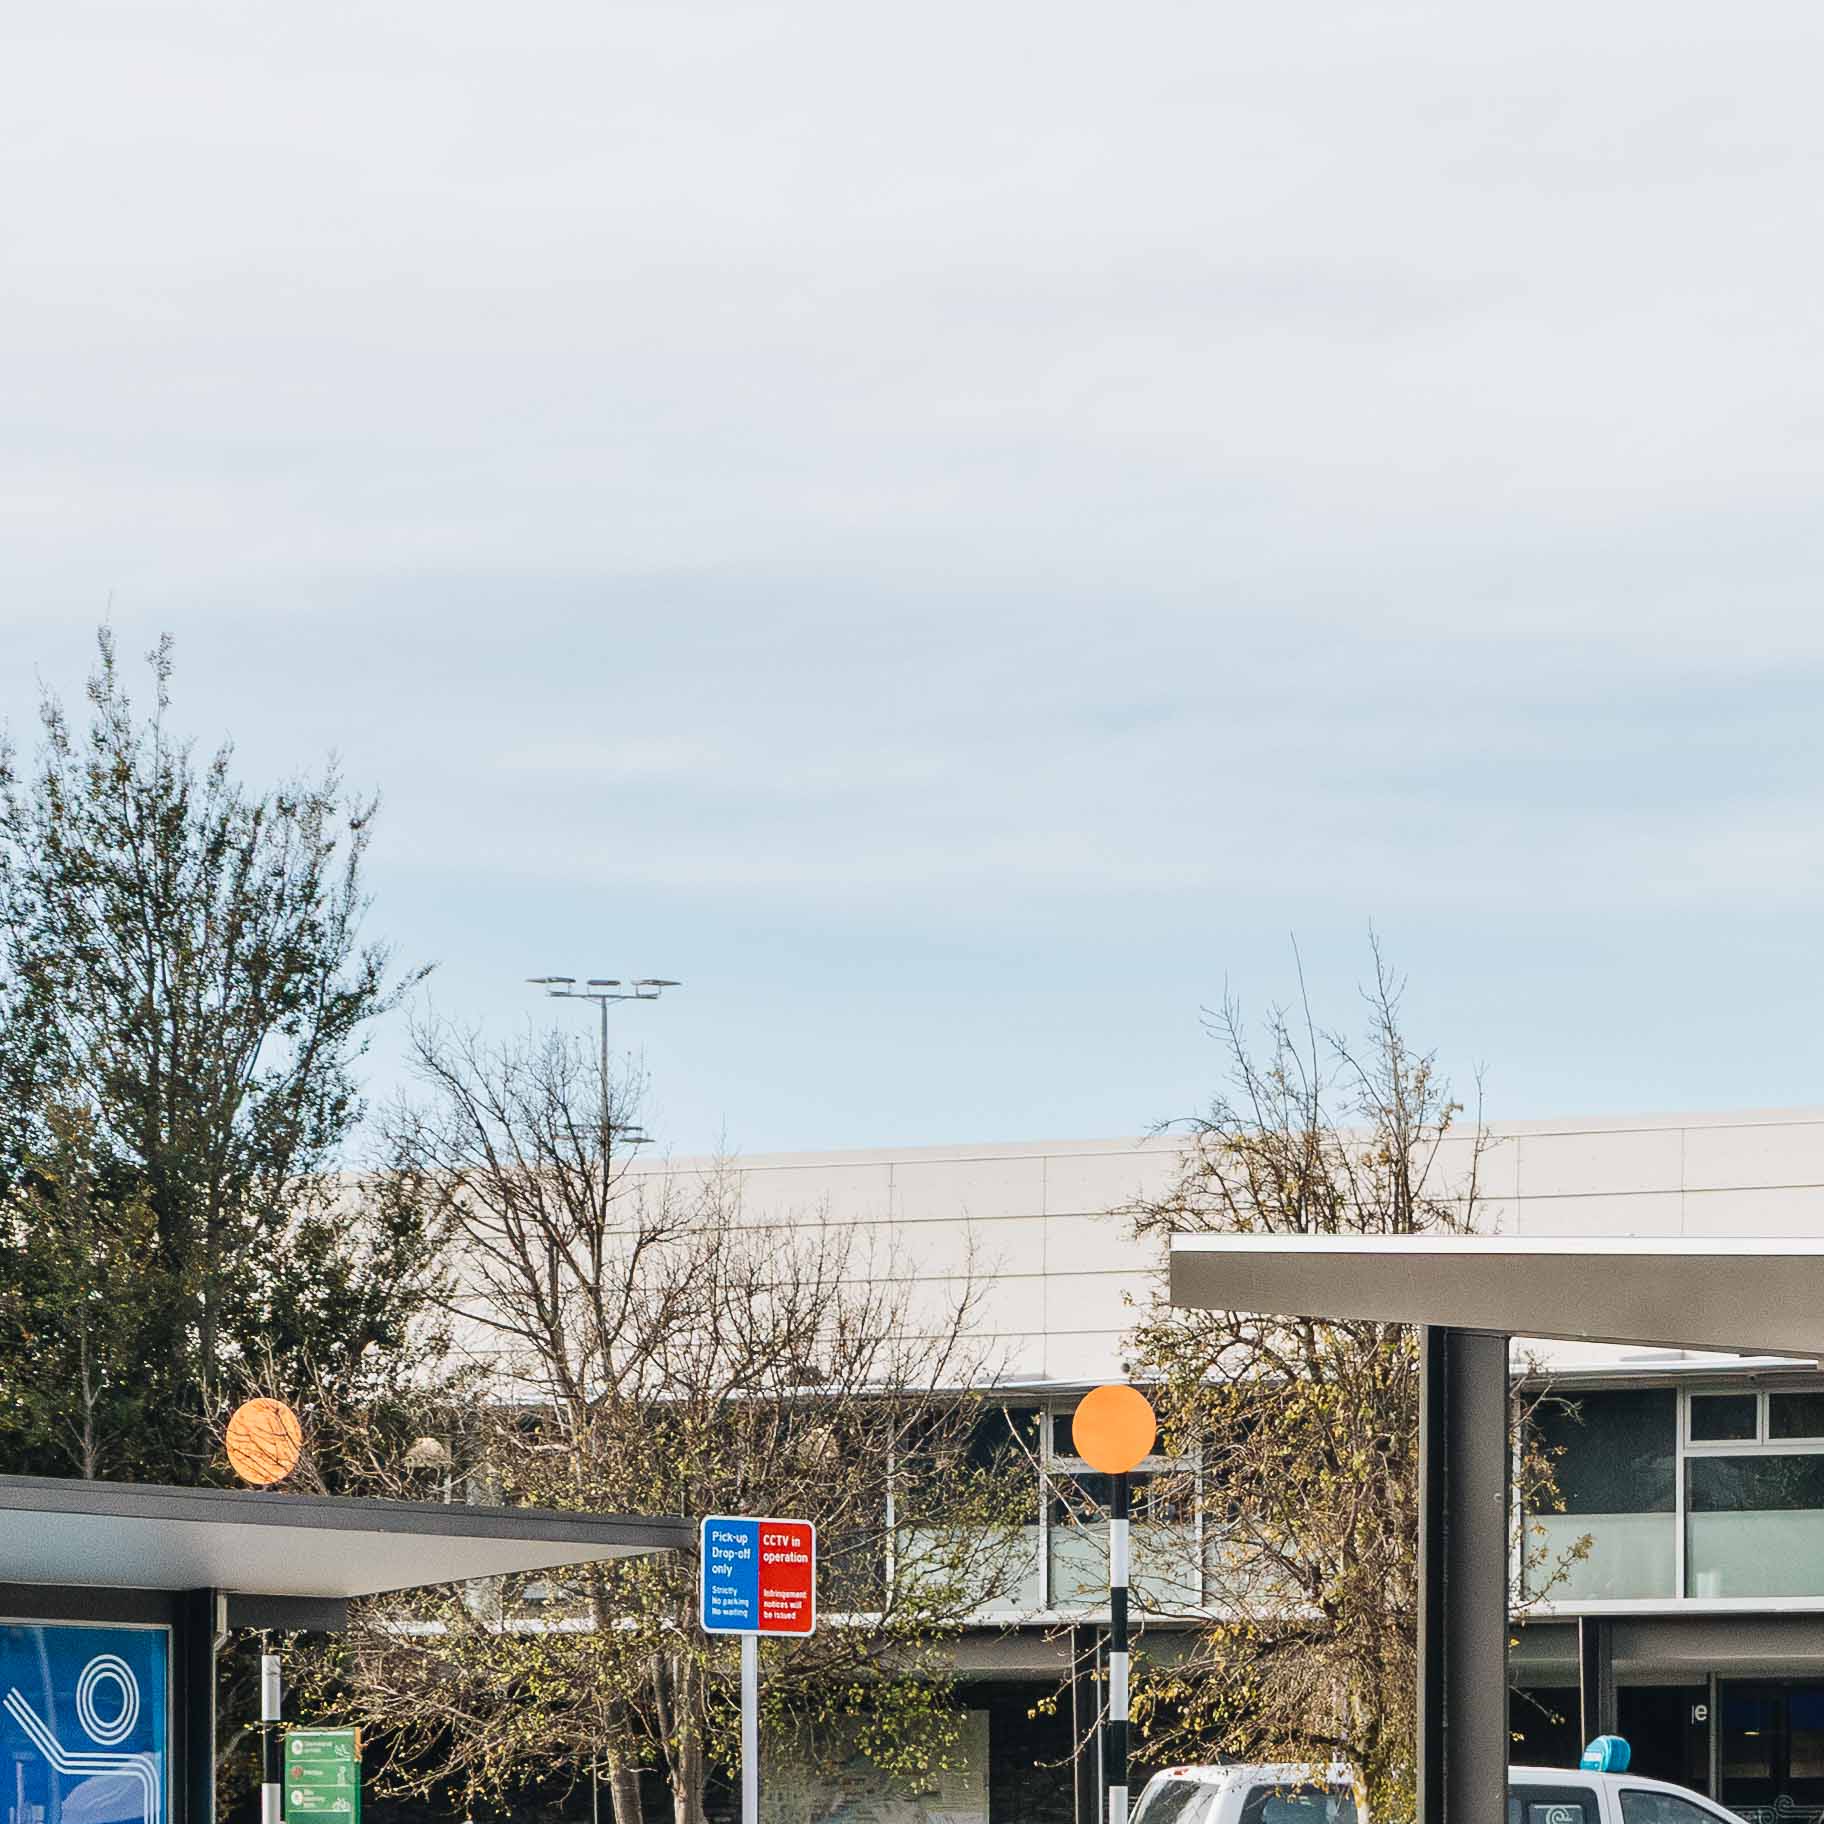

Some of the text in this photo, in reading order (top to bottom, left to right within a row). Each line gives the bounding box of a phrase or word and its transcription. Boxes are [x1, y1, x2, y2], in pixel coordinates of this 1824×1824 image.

[712, 1531, 748, 1546] Pick-up
[763, 1534, 801, 1547] CCTV in
[712, 1547, 751, 1561] Drop-off
[763, 1552, 808, 1564] operation
[711, 1564, 733, 1577] only
[763, 1588, 808, 1600] Infringement
[711, 1596, 749, 1608] No parking
[763, 1600, 802, 1609] notices will
[711, 1607, 748, 1619] No waiting
[763, 1610, 797, 1620] be issued
